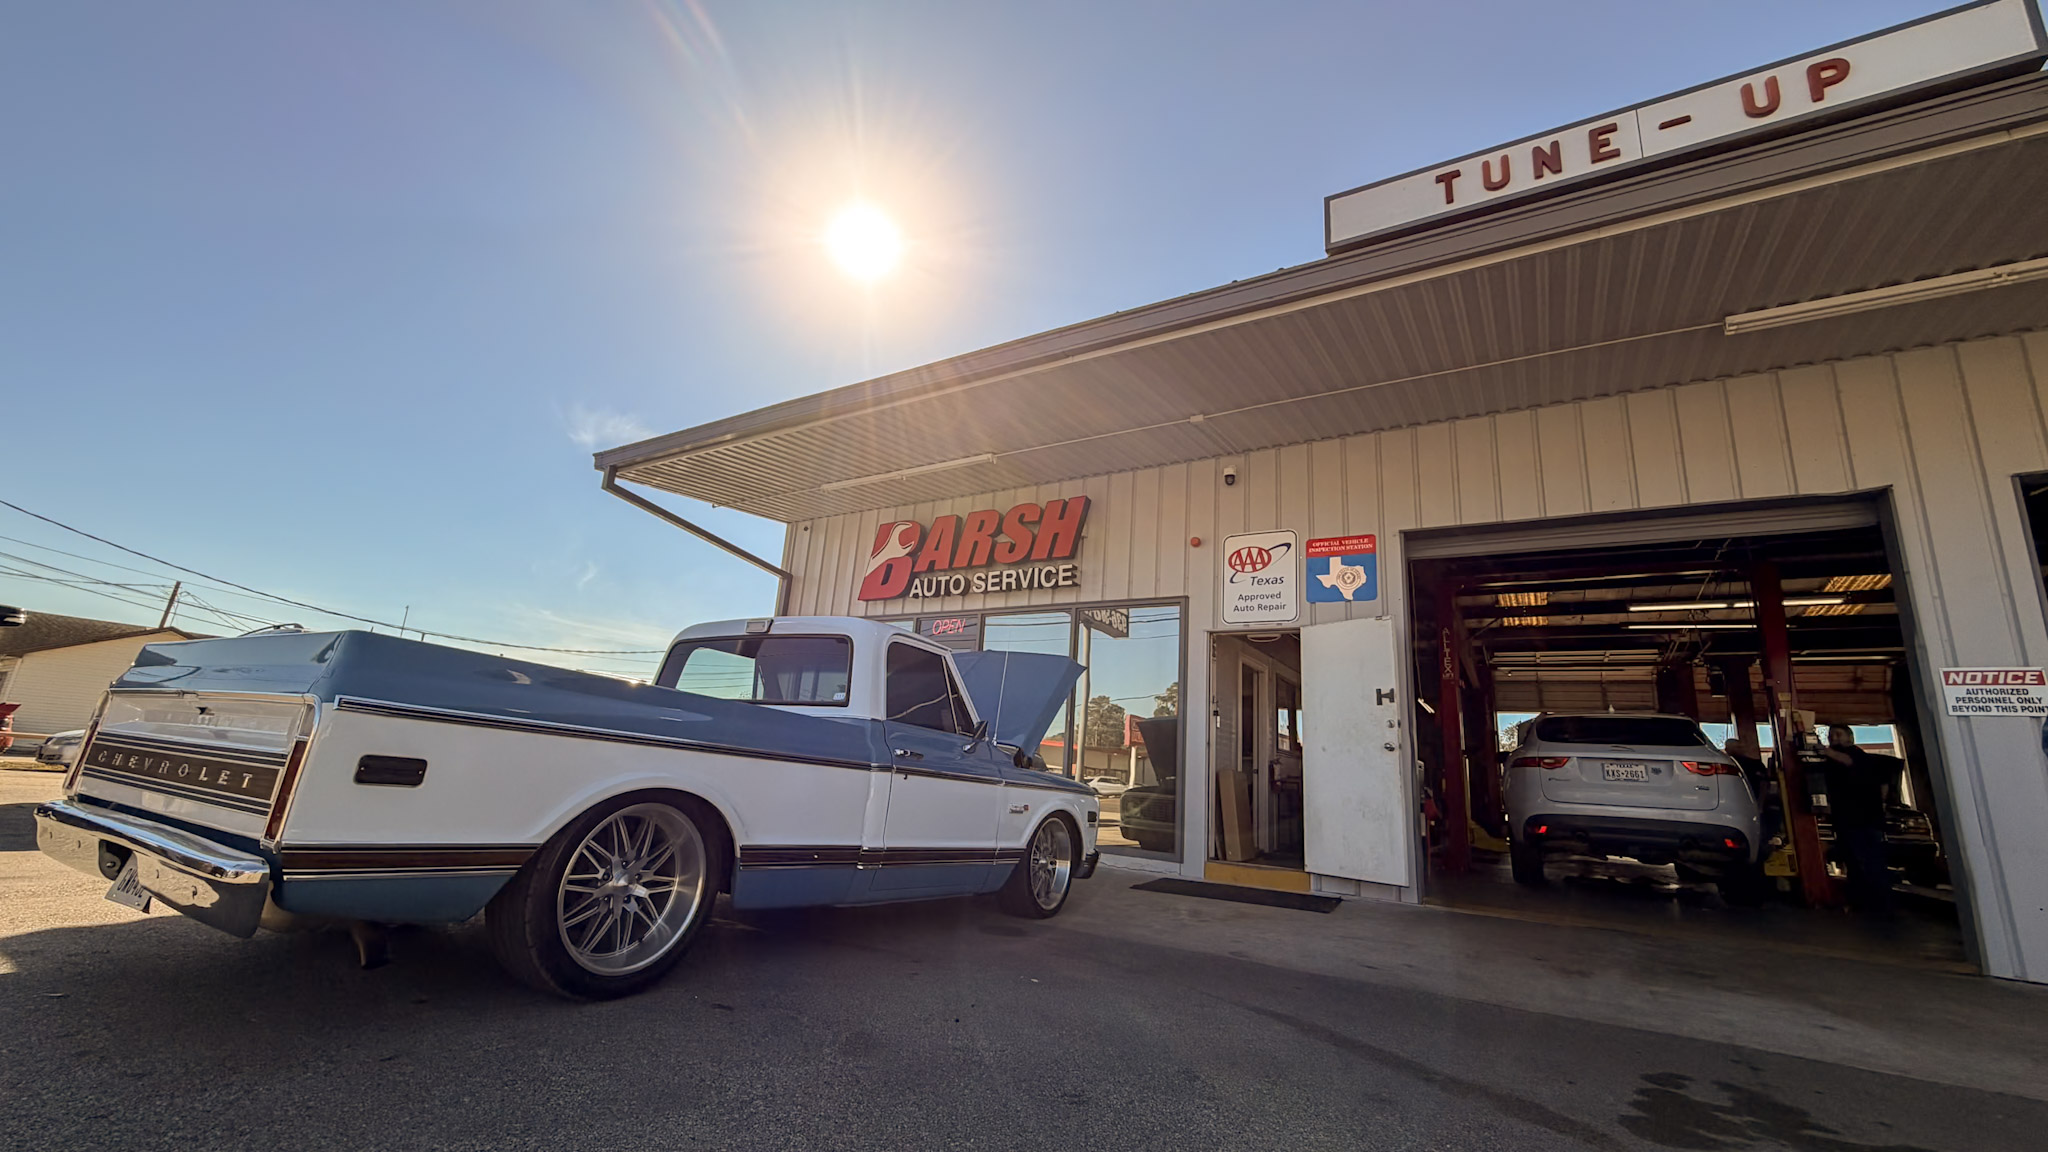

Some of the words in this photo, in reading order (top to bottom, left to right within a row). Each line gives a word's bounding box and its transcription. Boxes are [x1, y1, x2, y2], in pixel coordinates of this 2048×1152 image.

[1435, 122, 1621, 205] TUNE
[1739, 57, 1851, 119] UP
[858, 495, 1091, 600] BARSH
[1309, 545, 1345, 553] INSPECTION
[1346, 543, 1373, 551] STATION
[1231, 547, 1268, 572] AAA
[909, 574, 967, 599] AUTO
[972, 564, 1074, 594] SERVICE
[1251, 575, 1284, 587] Texas
[1237, 591, 1281, 602] Approved
[1233, 604, 1255, 613] Auto
[1257, 602, 1287, 613] Repair
[932, 618, 967, 635] OPEN
[1948, 672, 2040, 684] NOTICE
[1965, 688, 2029, 696] AUTHORIZED
[1955, 696, 2014, 704] PERSONNEL
[2016, 696, 2043, 705] ONLY
[1952, 705, 1992, 713] BEYOND
[1994, 705, 2018, 713] THIS
[98, 751, 253, 788] CHEVROLET
